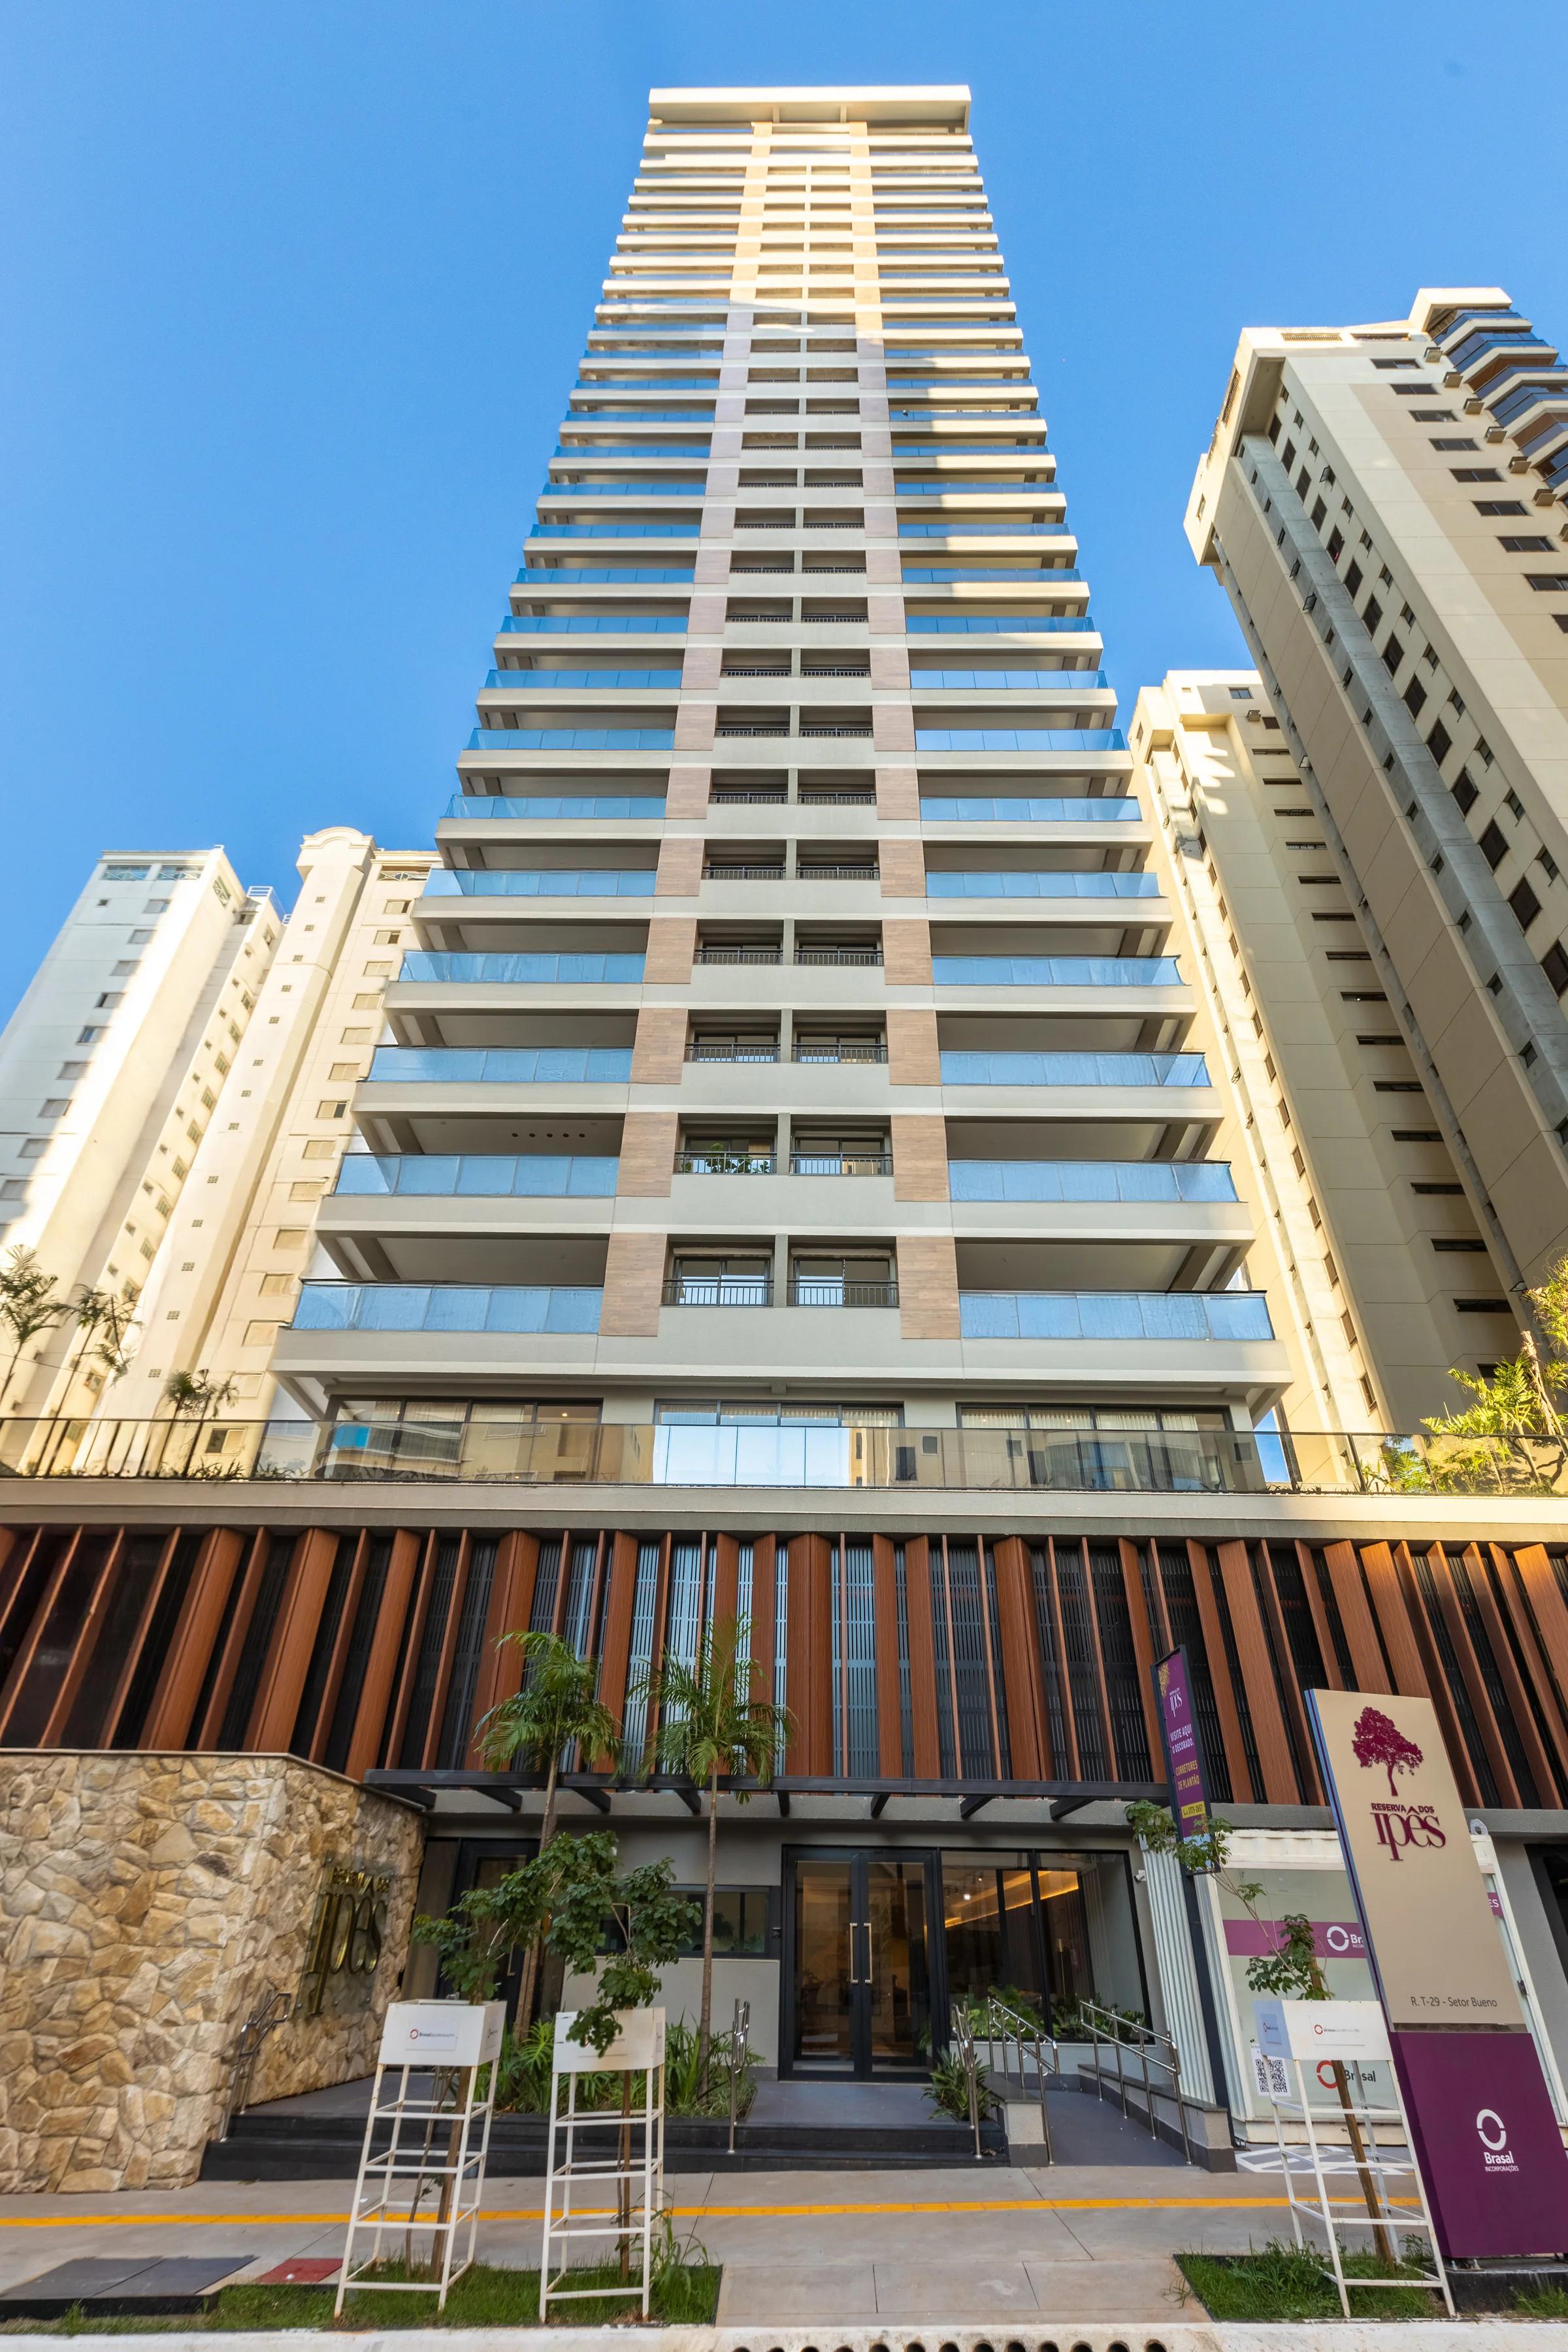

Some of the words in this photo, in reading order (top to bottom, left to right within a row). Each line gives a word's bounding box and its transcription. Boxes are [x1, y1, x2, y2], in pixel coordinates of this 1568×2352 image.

[1169, 1729, 1183, 1742] VISITE
[1182, 1723, 1192, 1736] AQUI
[1172, 1746, 1175, 1754] O
[1175, 1738, 1194, 1753] DECORADO.
[1175, 1760, 1198, 1776] CORRETORES
[1177, 1781, 1184, 1791] DE
[1183, 1774, 1200, 1789] PLANTÃO
[1371, 1802, 1407, 1812] RESERVA
[1411, 1996, 1419, 2006] R.
[1420, 1996, 1440, 2006] T-29
[1448, 1997, 1469, 2007] Setor
[1471, 1997, 1497, 2007] Bueno
[1344, 2070, 1376, 2082] Brsal
[1484, 2151, 1514, 2164] Brasal
